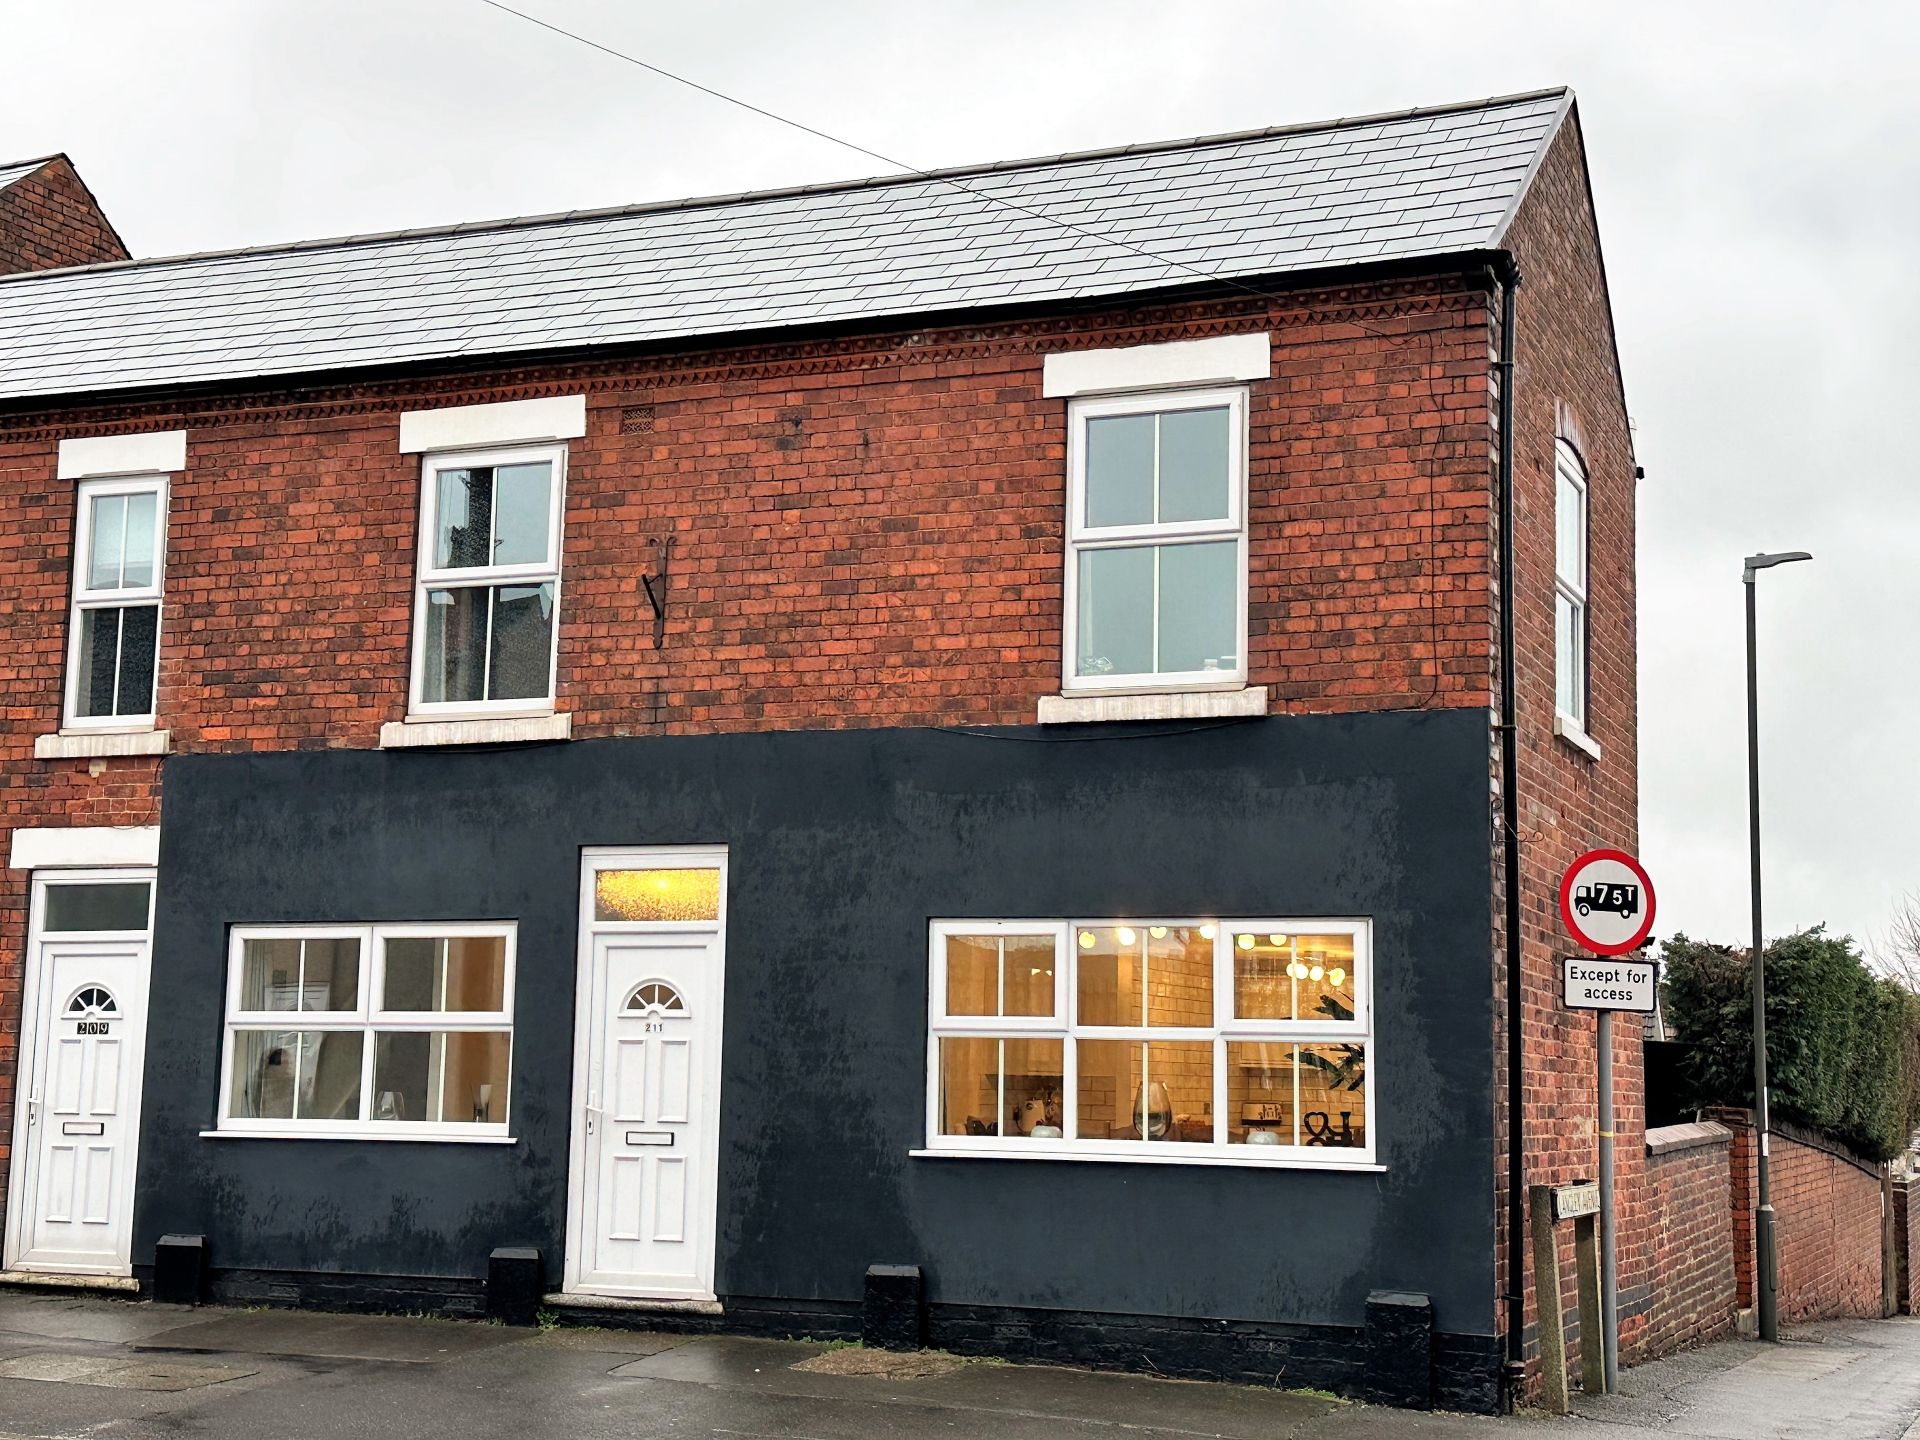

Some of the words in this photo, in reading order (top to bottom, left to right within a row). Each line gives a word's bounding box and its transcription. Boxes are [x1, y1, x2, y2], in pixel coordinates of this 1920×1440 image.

[1570, 966, 1620, 984] Except
[1627, 969, 1648, 984] for
[1584, 987, 1633, 1001] access
[78, 1022, 109, 1035] 209
[645, 1023, 663, 1032] 211
